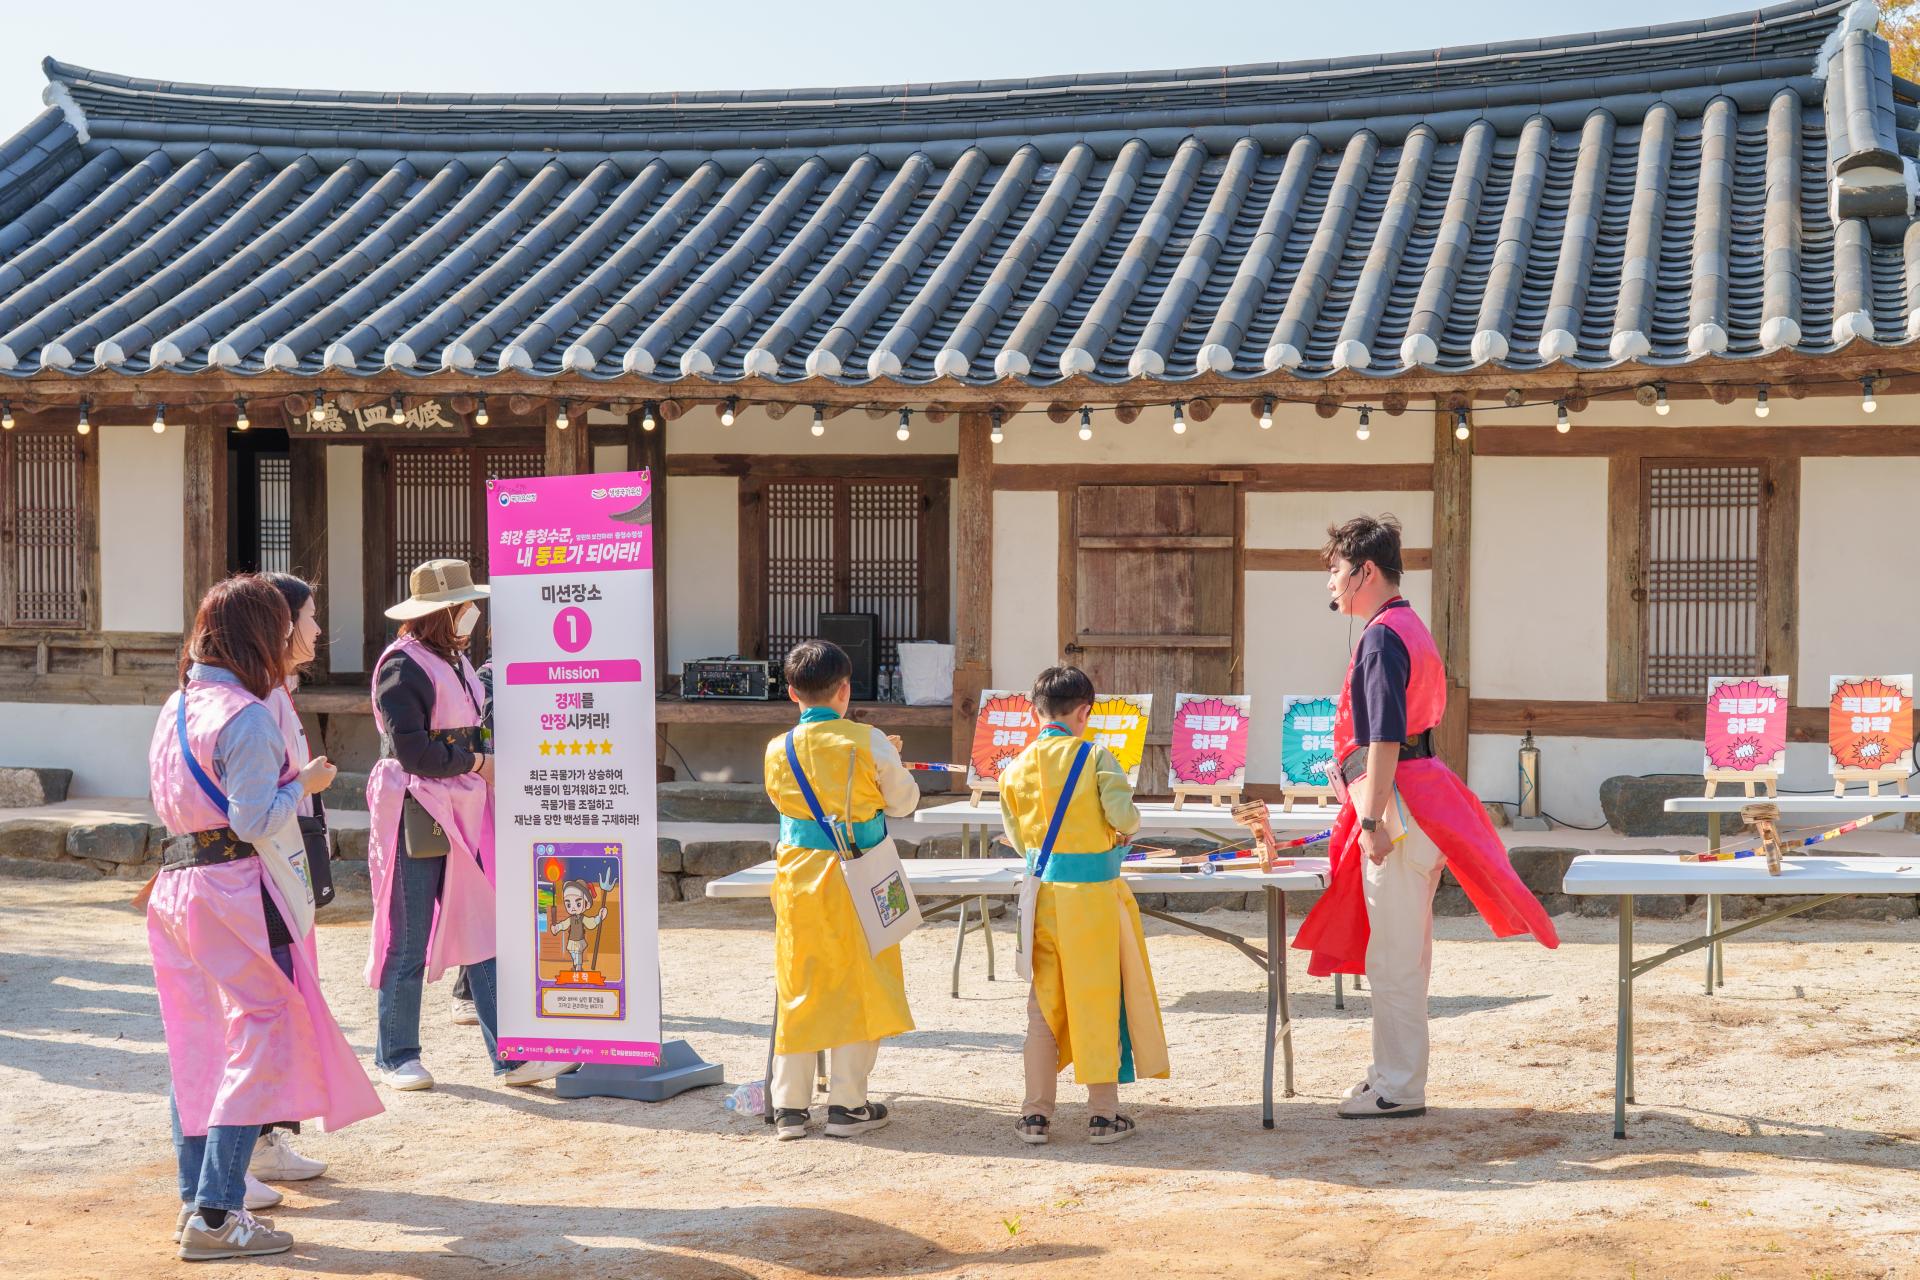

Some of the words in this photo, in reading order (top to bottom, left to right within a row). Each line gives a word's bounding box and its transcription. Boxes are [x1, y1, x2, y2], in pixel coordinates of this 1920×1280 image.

[500, 530, 522, 545] 최강
[525, 528, 573, 543] 충청수군,
[517, 547, 532, 567] 내
[536, 545, 584, 566] 동료가
[586, 542, 641, 564] 되어라!
[542, 584, 602, 603] 미션장소
[566, 615, 577, 643] 1
[548, 667, 600, 680] Mission
[556, 692, 594, 709] 경제를
[1719, 697, 1776, 714] 곡물가
[1841, 696, 1902, 714] 곡물가
[540, 712, 610, 730] 안정시켜라!
[1184, 714, 1239, 731] 곡물가
[1727, 717, 1766, 734] 하락
[1851, 716, 1891, 734] 하락
[993, 730, 1028, 746] 하락
[1192, 733, 1229, 750] 하락
[529, 769, 548, 781] 최근
[550, 769, 585, 781] 곡물가가
[588, 769, 623, 781] 상승하여
[524, 784, 560, 796] 백성들이
[562, 784, 607, 796] 힘겨워하고
[609, 784, 629, 795] 있다.
[540, 799, 576, 811] 곡물가를
[578, 799, 614, 810] 조절하고
[514, 815, 542, 826] 재난을
[544, 814, 562, 826] 당한
[564, 814, 601, 826] 백성들을
[602, 814, 640, 826] 구제하라!
[227, 1226, 255, 1247] N
